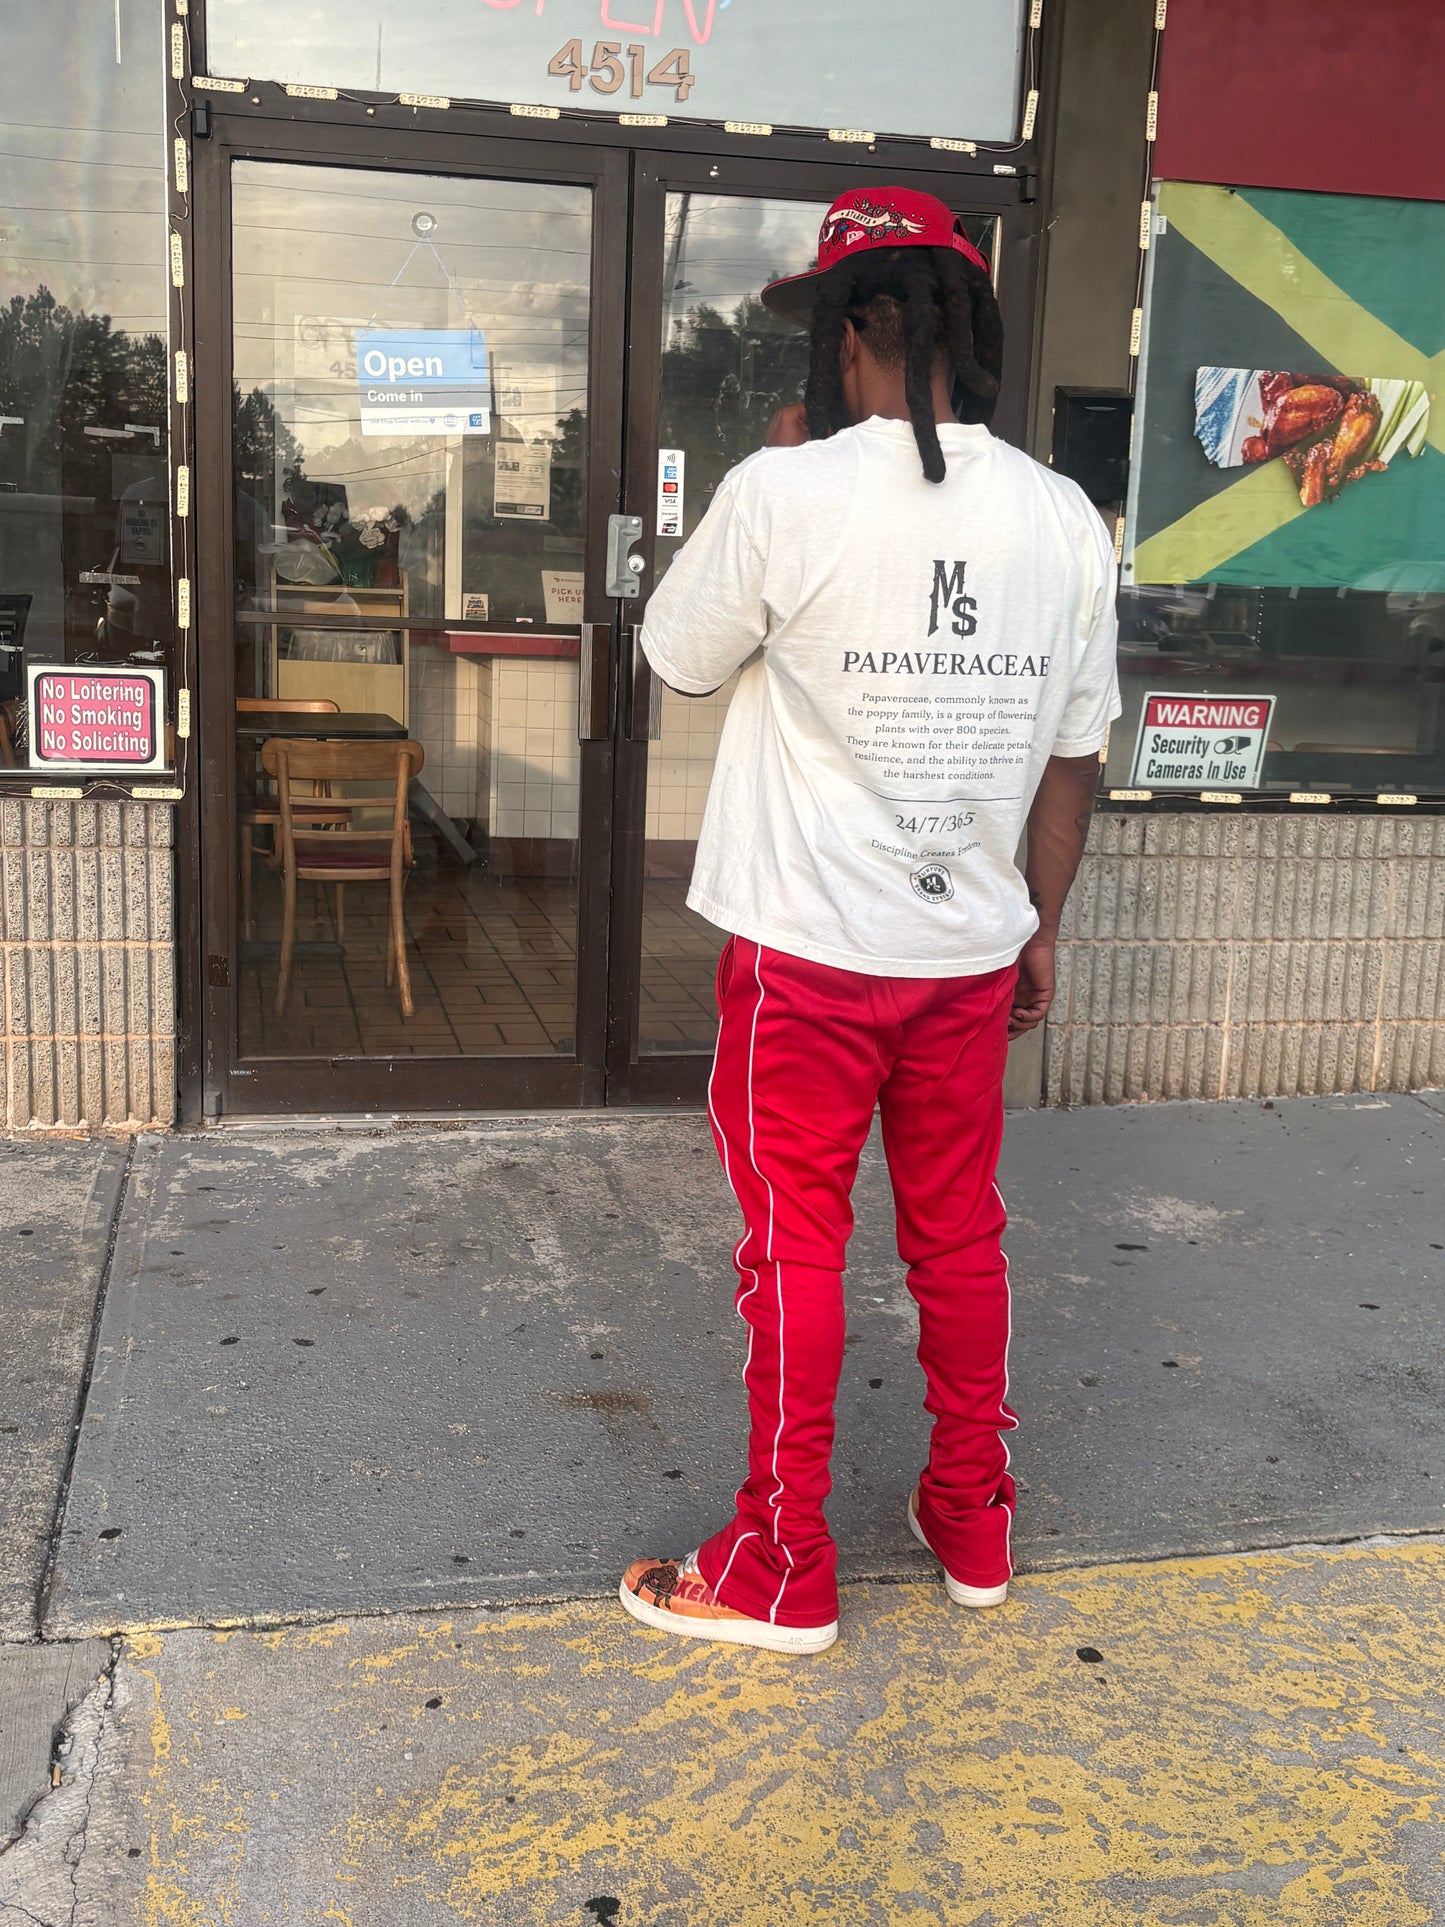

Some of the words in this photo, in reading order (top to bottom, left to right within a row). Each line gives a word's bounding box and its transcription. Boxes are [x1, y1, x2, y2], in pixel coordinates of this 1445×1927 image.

[548, 38, 695, 102] 4514
[845, 210, 872, 225] ATLANTA
[364, 350, 443, 383] Open
[367, 389, 407, 403] Come
[410, 389, 423, 402] in
[551, 587, 573, 596] PICK
[575, 588, 585, 596] U
[558, 595, 582, 604] HERE
[841, 651, 1050, 677] PAPAVERACEAE
[42, 678, 65, 700] No
[70, 678, 145, 707] Loitering
[934, 695, 986, 706] commonly
[988, 695, 1016, 705] known
[1017, 697, 1029, 705] as
[43, 703, 66, 724] No
[71, 704, 142, 732] Smoking
[848, 706, 864, 716] the
[866, 709, 899, 721] poppy
[901, 709, 934, 721] family,
[936, 710, 944, 719] is
[955, 711, 985, 722] group
[987, 710, 997, 720] of
[1156, 703, 1260, 726] WARNING
[875, 723, 906, 735] plants
[909, 725, 930, 734] with
[932, 726, 954, 735] over
[956, 725, 977, 735] 800
[43, 729, 66, 750] No
[71, 730, 149, 757] Soliciting
[846, 735, 870, 748] They
[872, 740, 889, 748] are
[891, 740, 926, 750] known
[928, 740, 943, 750] for
[945, 740, 969, 750] their
[971, 740, 1005, 750] delicate
[1151, 733, 1210, 759] Security
[854, 752, 904, 765] resilience,
[906, 755, 926, 765] and
[928, 755, 945, 765] the
[947, 755, 977, 767] ability
[979, 756, 988, 765] to
[990, 755, 1014, 765] thrive
[1015, 755, 1024, 764] in
[1146, 759, 1203, 779] Cameras
[1207, 760, 1219, 780] In
[1223, 760, 1247, 780] Use
[883, 769, 900, 778] the
[902, 769, 945, 780] harshest
[947, 771, 996, 780] conditions.
[895, 811, 976, 834] 24/7/365
[871, 839, 918, 860] Discipline
[920, 849, 955, 858] Creates
[673, 1579, 727, 1608] KEN
[787, 1636, 803, 1647] AIR
